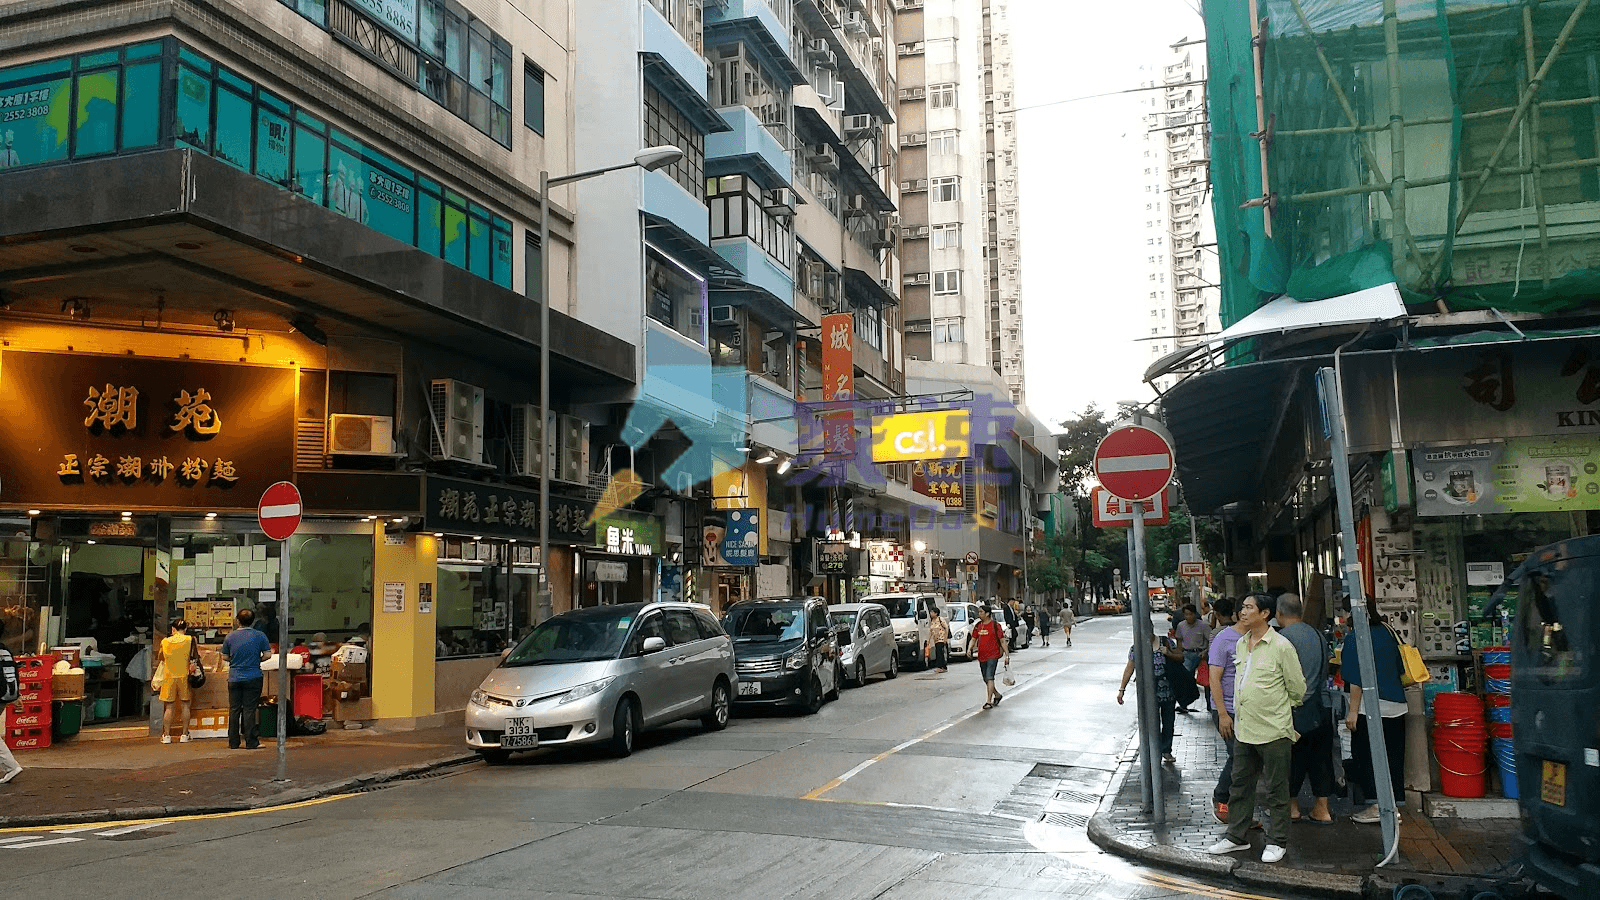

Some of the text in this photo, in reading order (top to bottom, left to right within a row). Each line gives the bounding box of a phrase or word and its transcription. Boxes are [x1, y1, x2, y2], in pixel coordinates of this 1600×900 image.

[386, 5, 413, 35] 8885
[4, 105, 49, 122] 2552 3808
[378, 190, 410, 213] 2552 3808
[83, 382, 222, 435] 潮苑
[945, 496, 963, 506] 0388
[439, 487, 590, 536] 潮苑正宗潮粉麵
[606, 525, 635, 555] 魚米
[725, 540, 737, 549] NICE
[509, 726, 531, 735] 3133
[512, 718, 525, 727] NK
